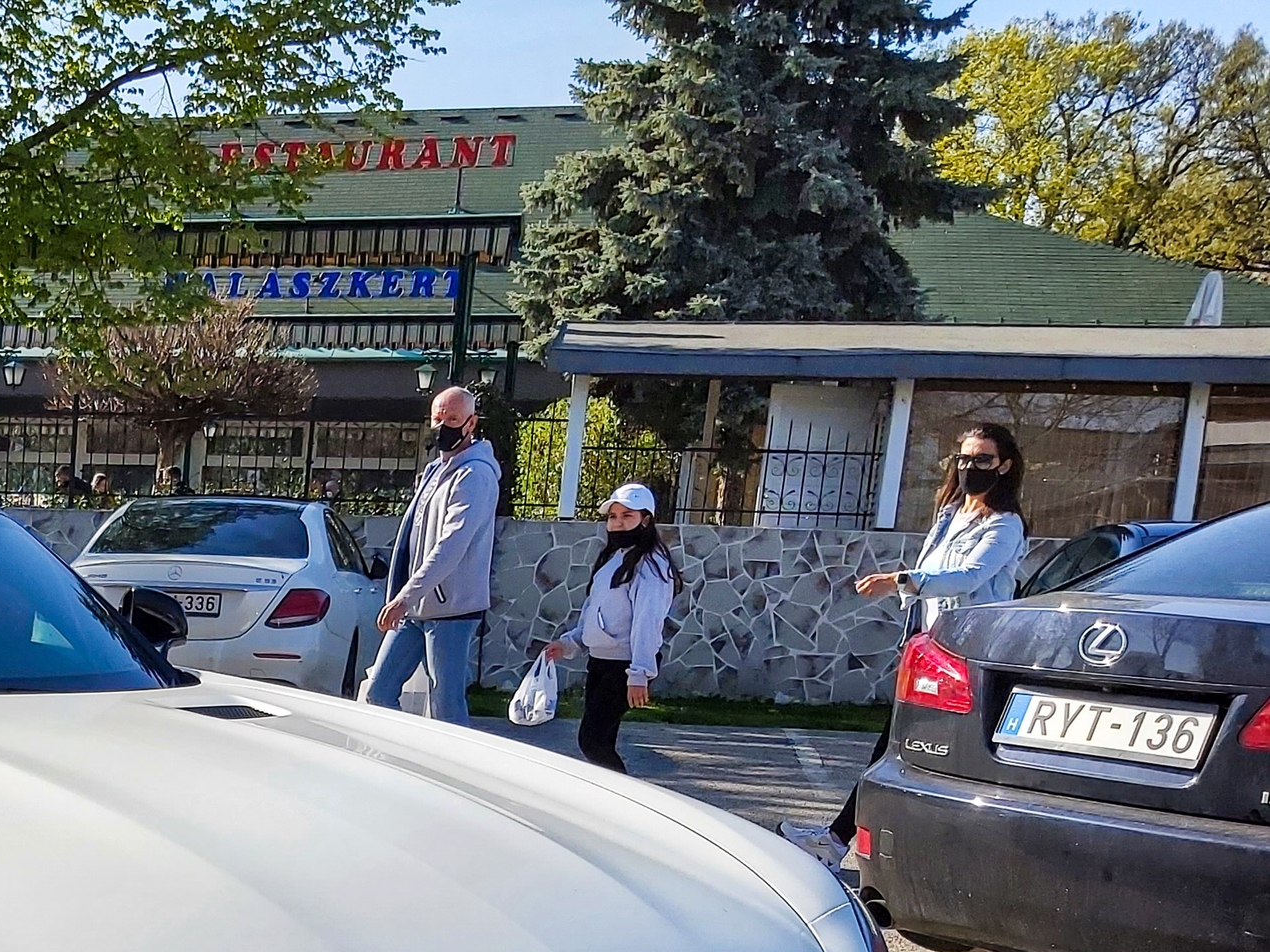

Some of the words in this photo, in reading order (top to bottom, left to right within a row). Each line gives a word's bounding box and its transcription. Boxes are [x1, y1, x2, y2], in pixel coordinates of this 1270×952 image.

[218, 134, 517, 173] ESTAURANT
[1006, 717, 1018, 732] H
[1026, 700, 1200, 754] RYT-136
[905, 738, 950, 756] LEXUS
